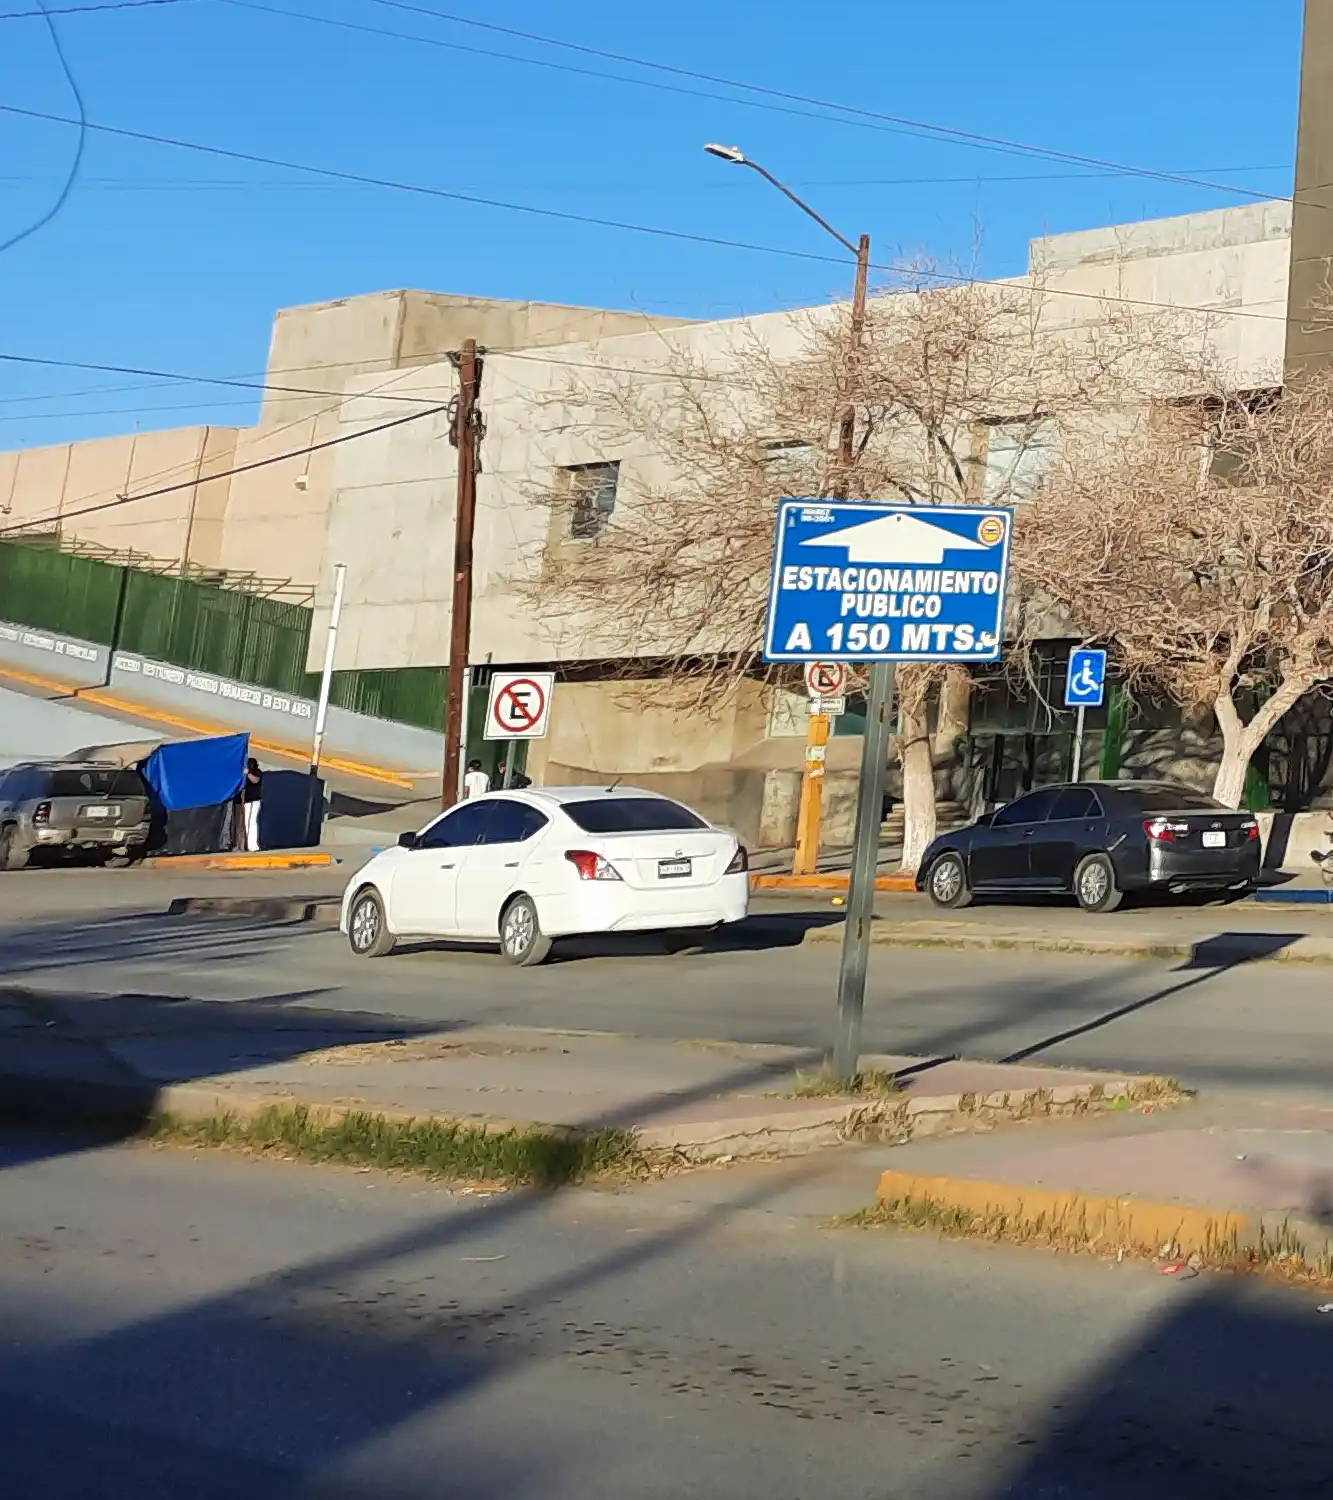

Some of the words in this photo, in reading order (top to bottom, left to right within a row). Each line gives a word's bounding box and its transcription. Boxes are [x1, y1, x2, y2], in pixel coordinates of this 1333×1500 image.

[782, 565, 999, 596] ESTACIONAMIENTO
[840, 594, 943, 619] PUBLICO
[784, 622, 813, 651] A
[825, 622, 891, 651] 150
